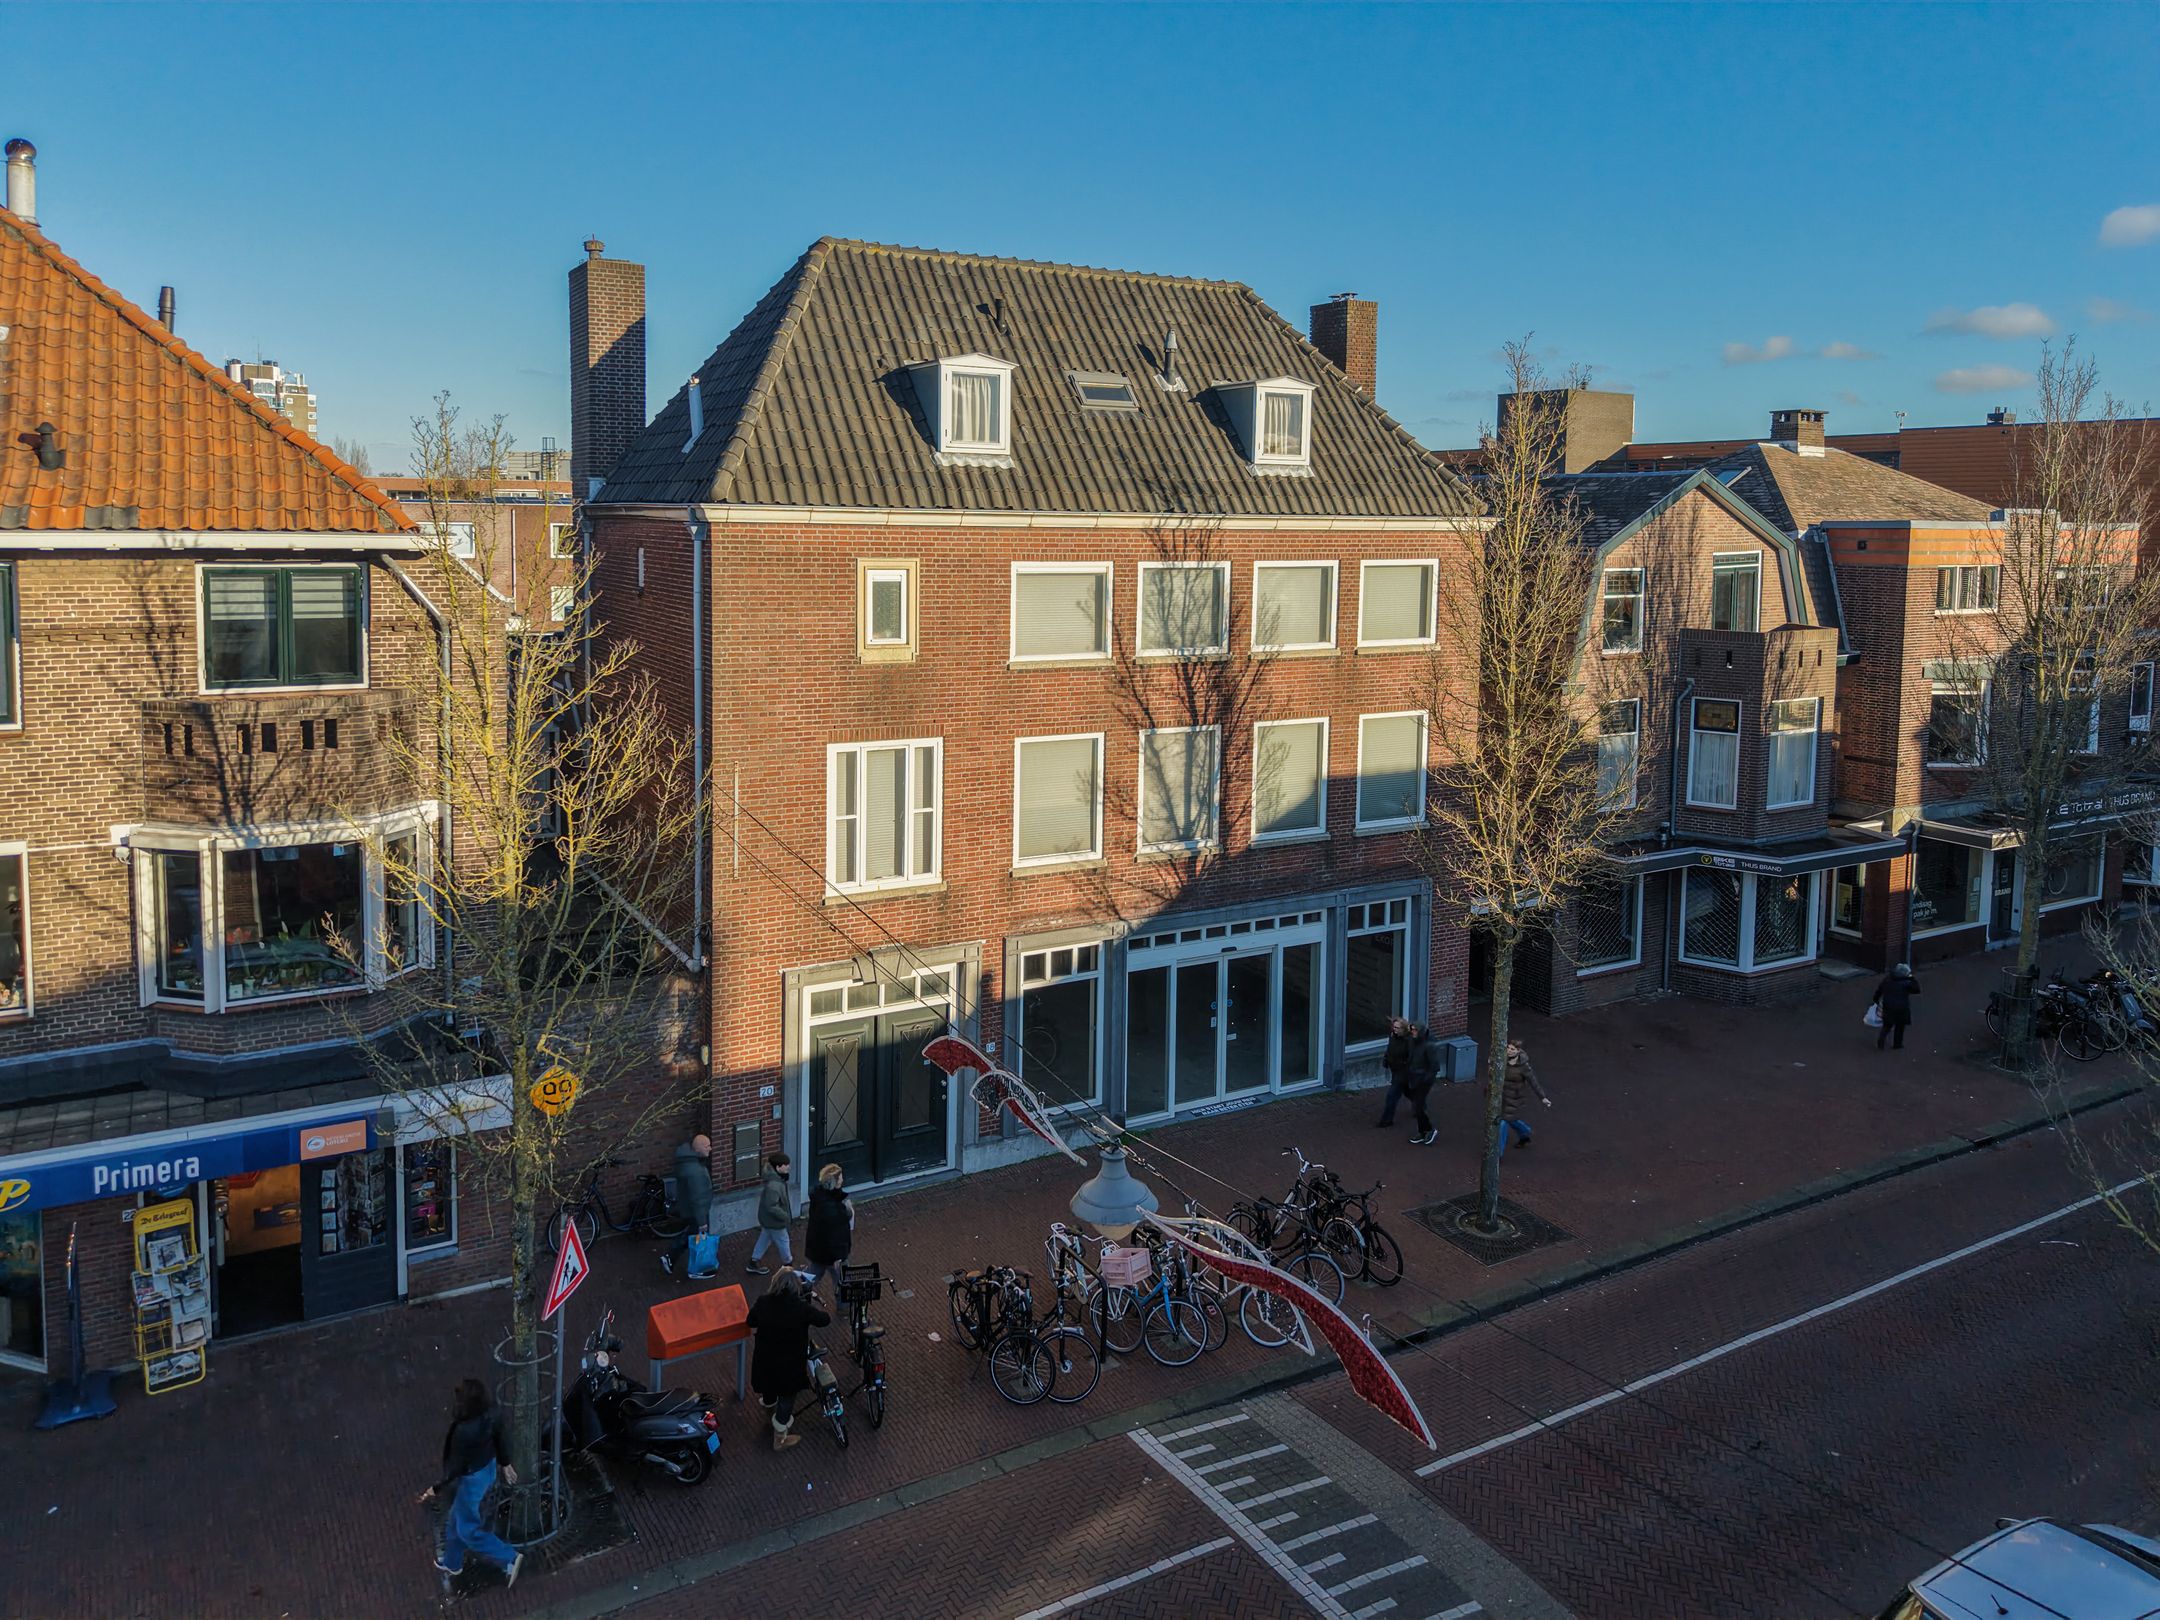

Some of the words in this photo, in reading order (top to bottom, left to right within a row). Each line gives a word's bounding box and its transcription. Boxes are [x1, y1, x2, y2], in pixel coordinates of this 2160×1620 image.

[1741, 861, 1758, 869] THUS
[1759, 863, 1782, 873] BRAND
[761, 1087, 773, 1096] 20
[94, 1156, 200, 1195] Primera
[141, 1216, 152, 1225] De
